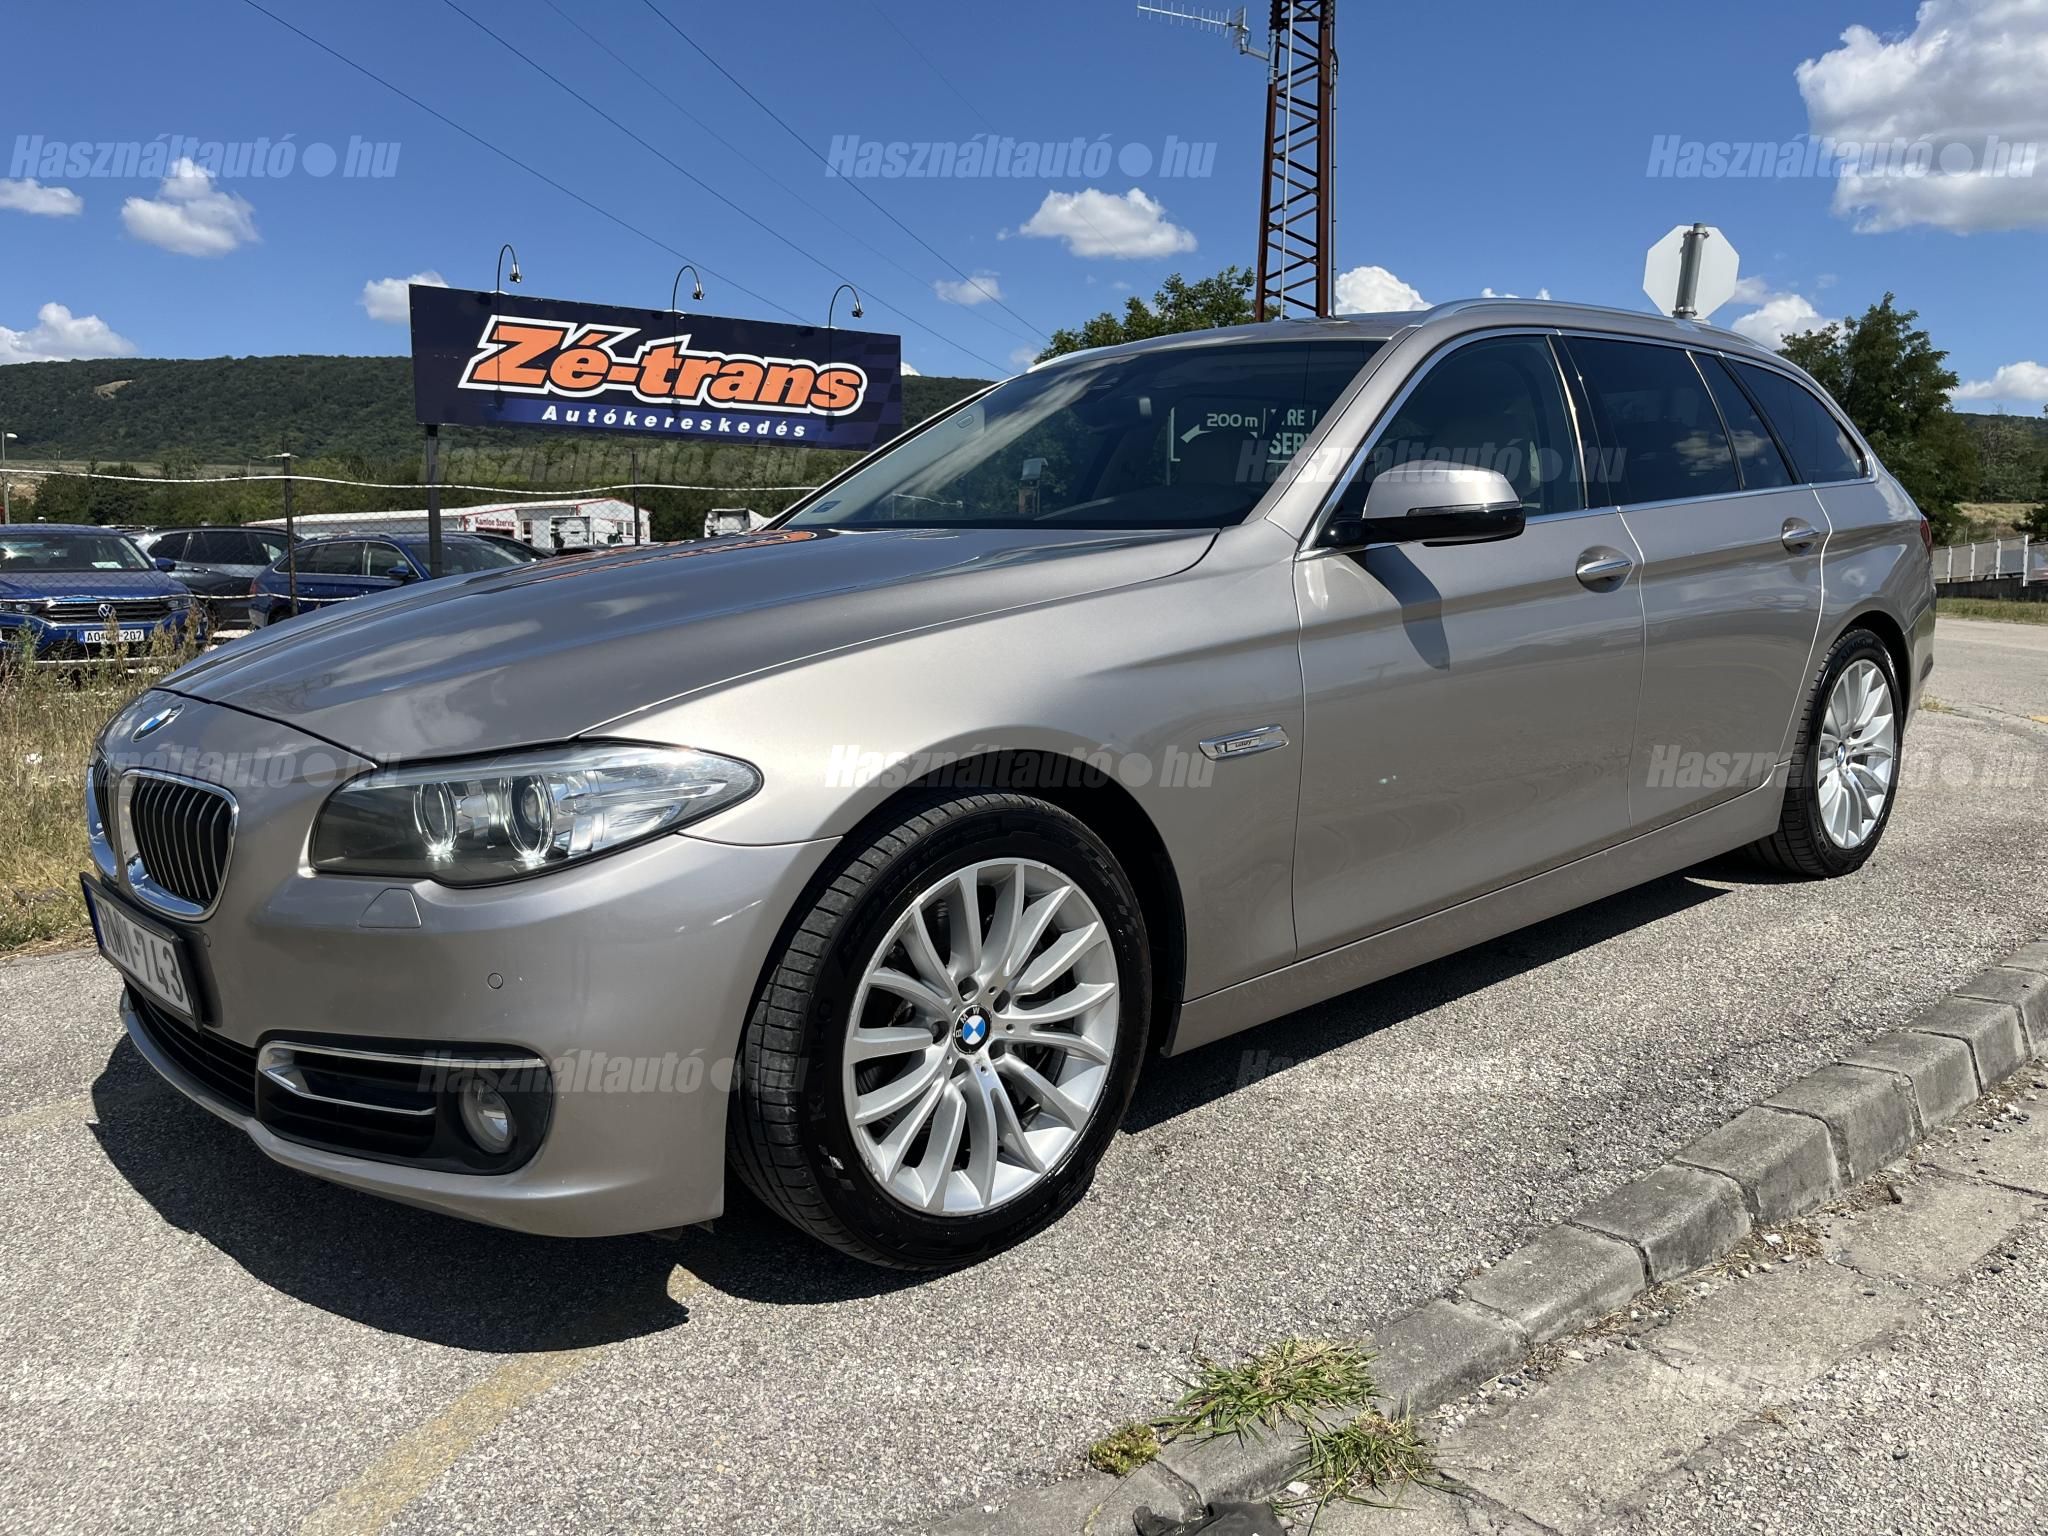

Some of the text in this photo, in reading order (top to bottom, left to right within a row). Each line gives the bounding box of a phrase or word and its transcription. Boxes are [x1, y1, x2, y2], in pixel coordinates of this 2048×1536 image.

[466, 320, 866, 414] Zé-trans
[542, 405, 805, 437] Autókereskedés
[1206, 413, 1242, 428] 200
